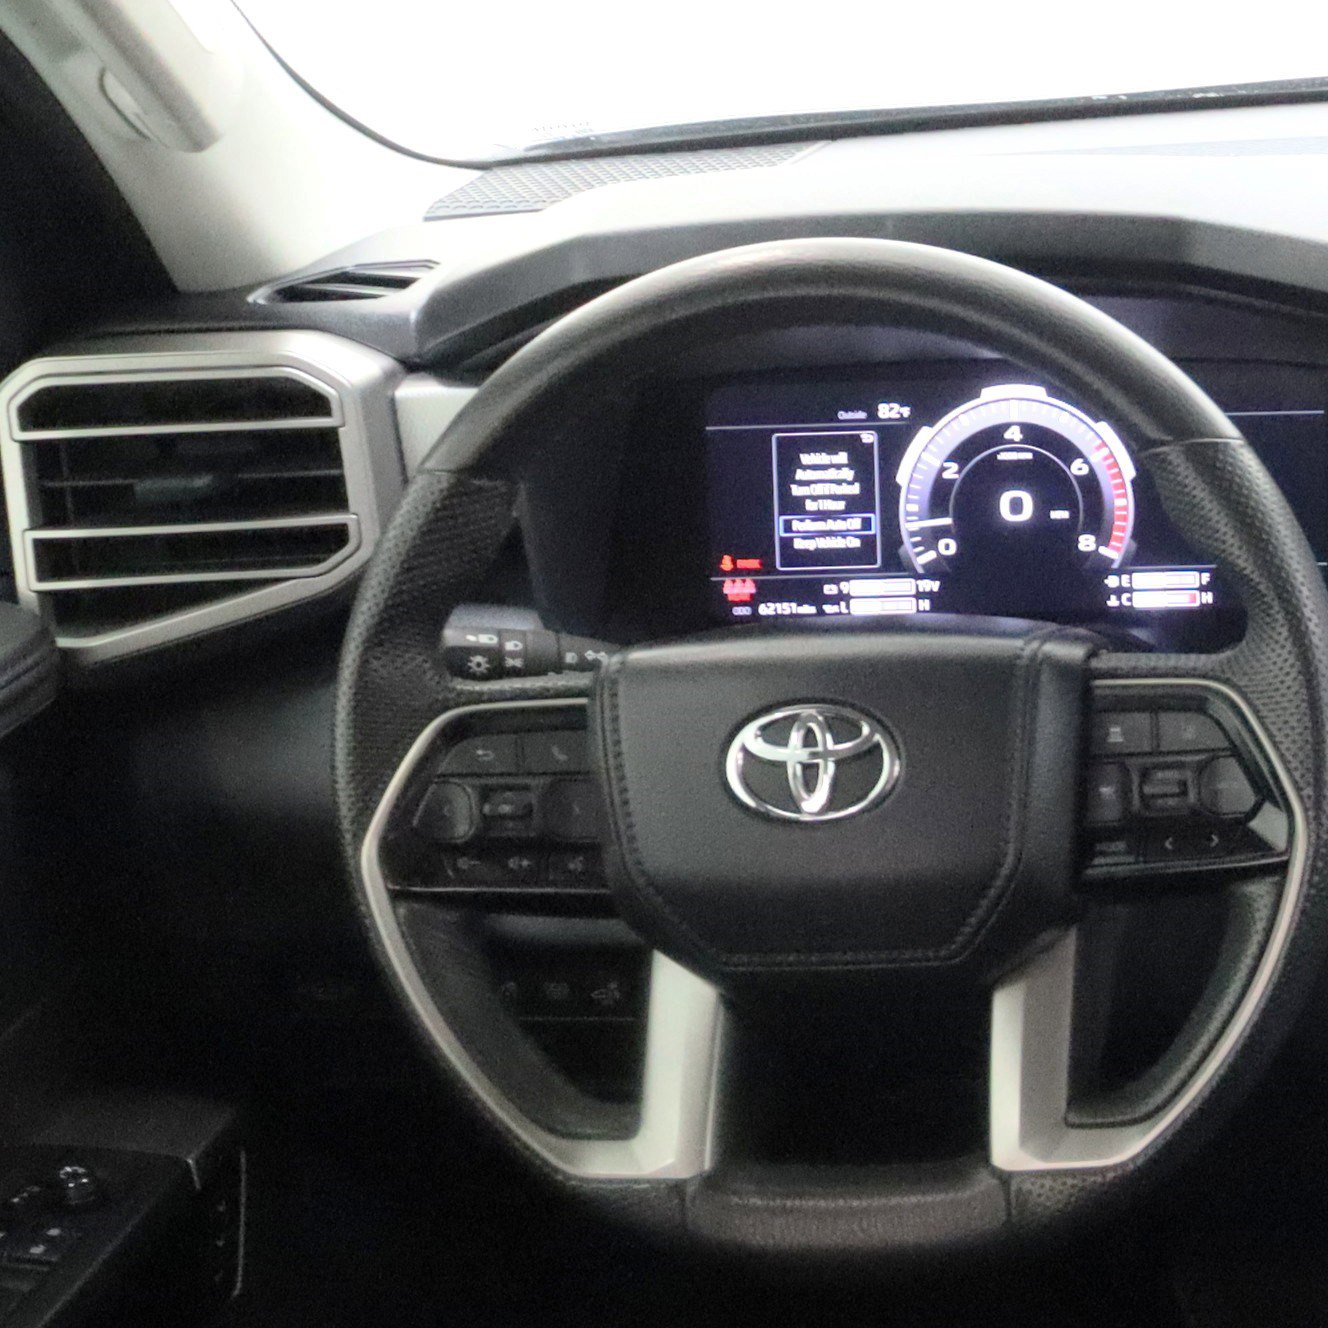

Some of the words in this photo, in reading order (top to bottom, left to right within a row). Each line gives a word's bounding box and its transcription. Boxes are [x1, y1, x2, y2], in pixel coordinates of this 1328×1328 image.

[1003, 425, 1023, 442] 4
[942, 462, 959, 477] 2
[1070, 458, 1089, 476] 6
[999, 490, 1034, 522] 0
[939, 538, 957, 555] 0
[1078, 534, 1096, 552] 8
[1121, 574, 1131, 587] E
[1201, 573, 1211, 585] F
[919, 599, 930, 611] H
[1121, 593, 1132, 606] C
[1201, 591, 1213, 604] H
[758, 602, 797, 615] 62151
